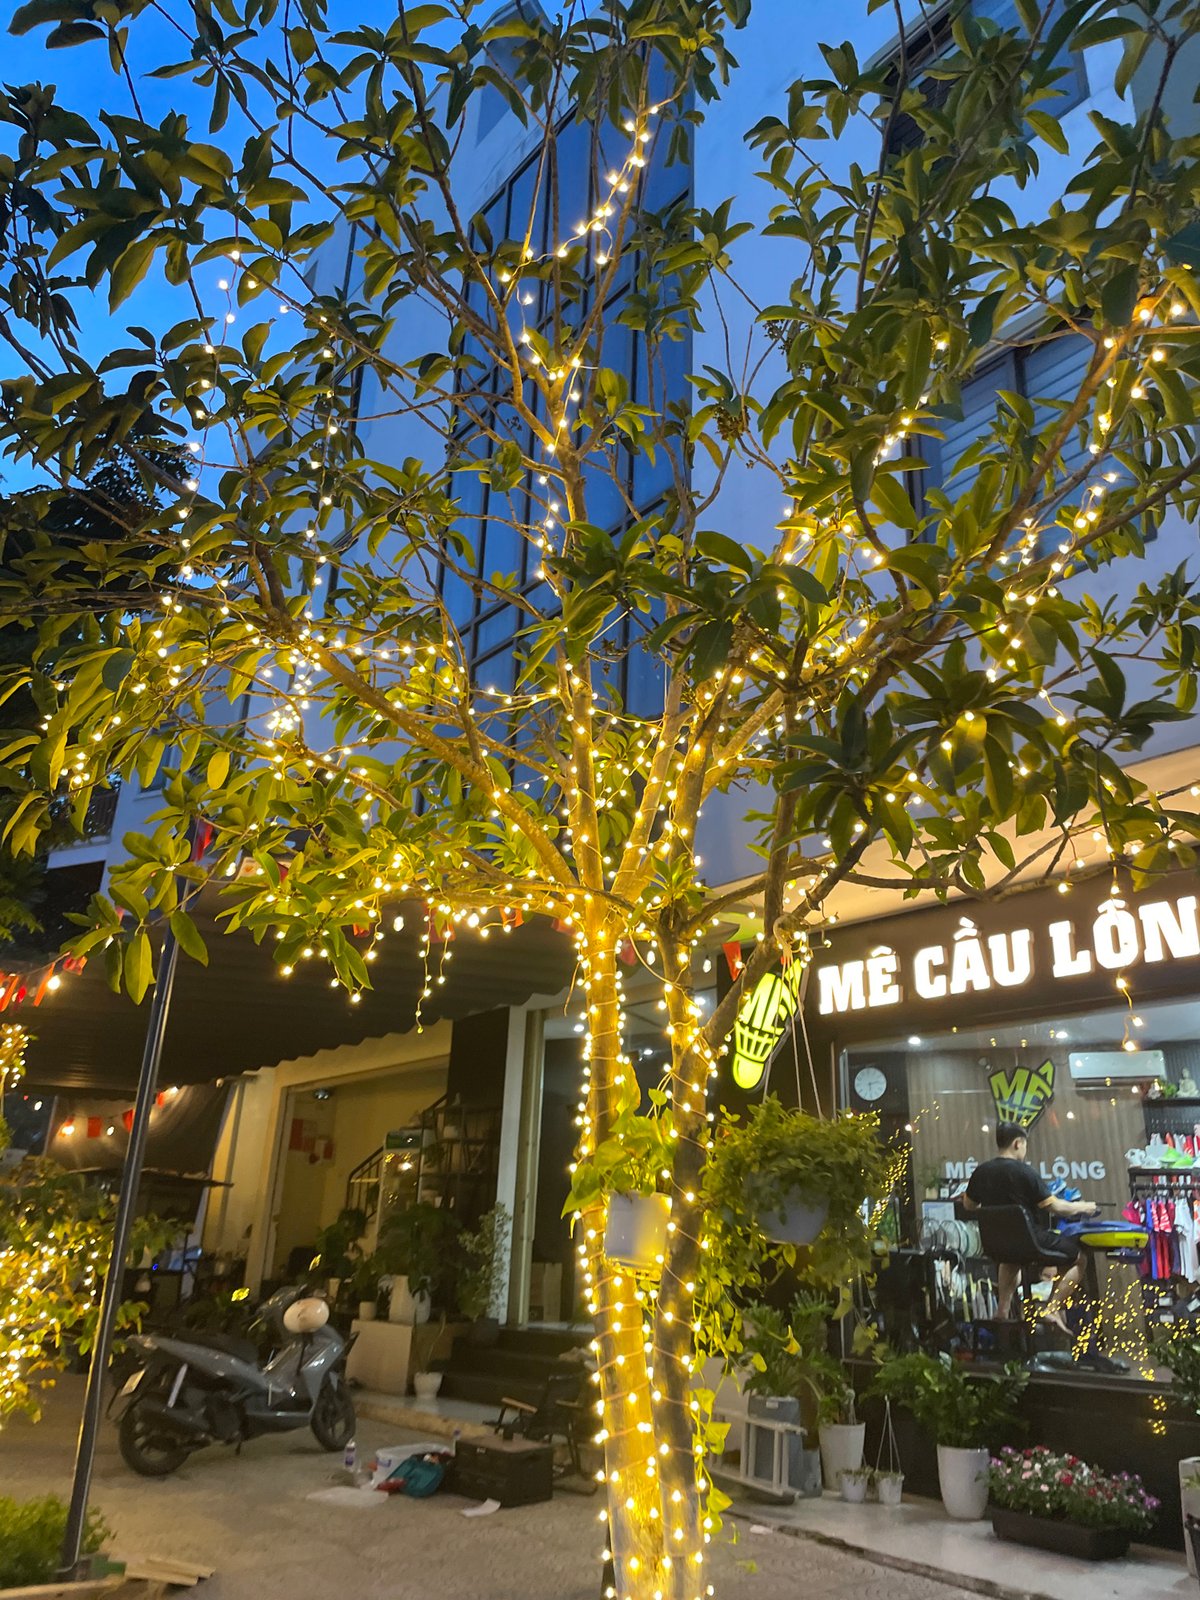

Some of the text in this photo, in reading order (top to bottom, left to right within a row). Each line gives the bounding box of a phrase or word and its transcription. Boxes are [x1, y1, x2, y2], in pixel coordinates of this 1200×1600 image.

[817, 945, 900, 1015] MÊ
[913, 915, 1033, 999] CẦU
[1039, 1156, 1106, 1180] LÔNG
